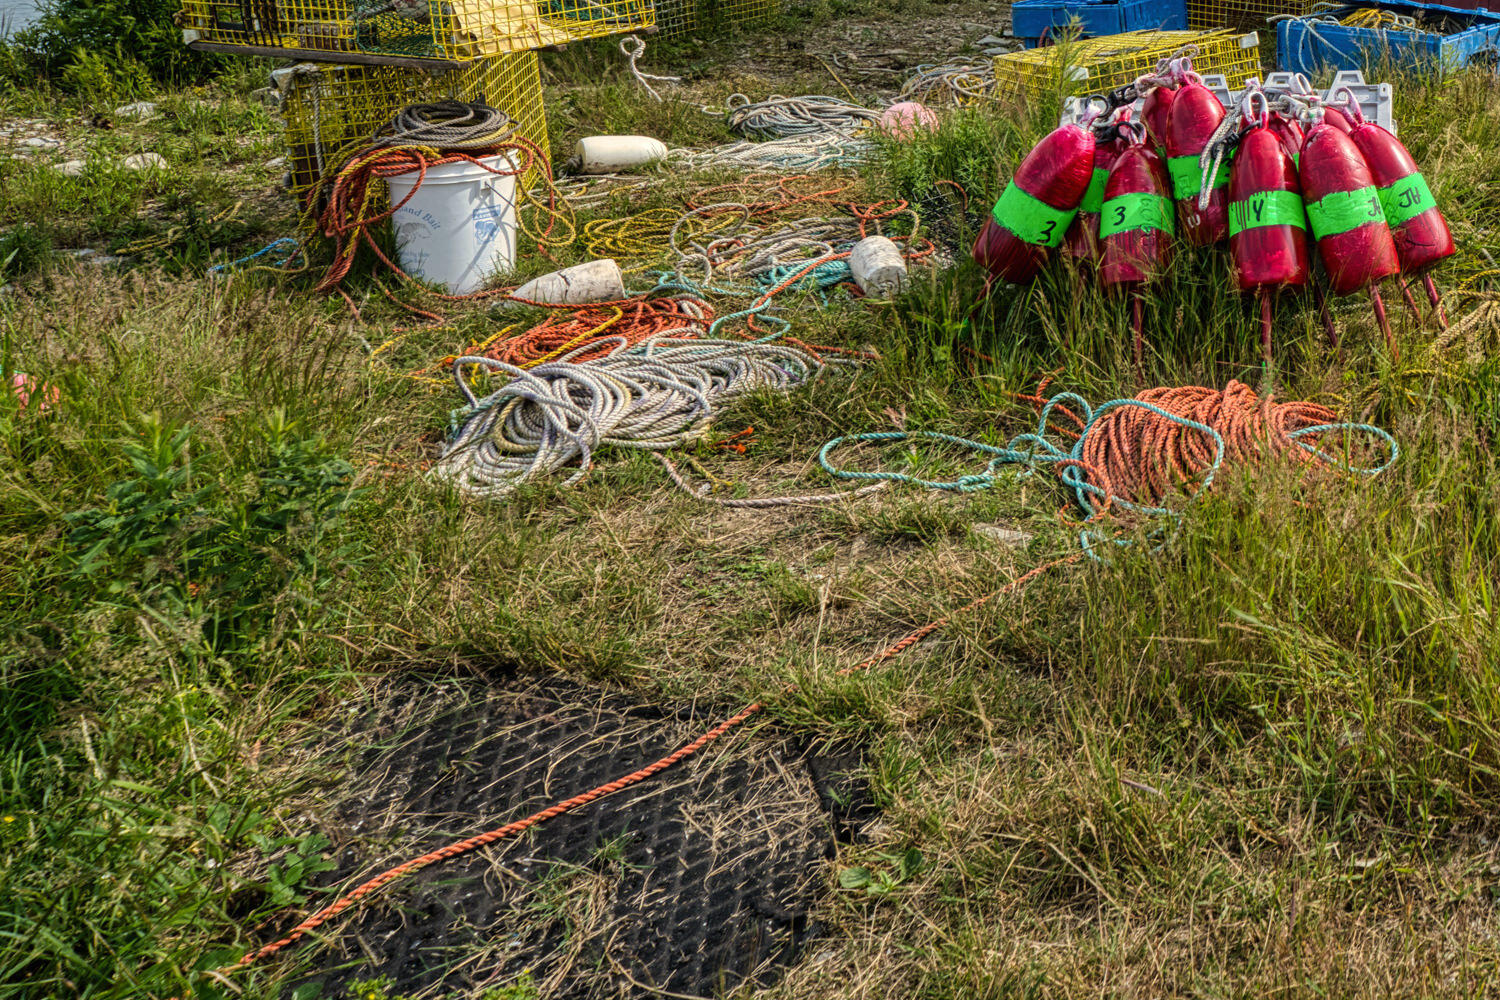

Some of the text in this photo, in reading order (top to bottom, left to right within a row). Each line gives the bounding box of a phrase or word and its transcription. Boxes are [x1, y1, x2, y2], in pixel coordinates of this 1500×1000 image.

[1398, 186, 1421, 208] JH
[1112, 206, 1127, 227] 3
[1036, 220, 1057, 244] 3
